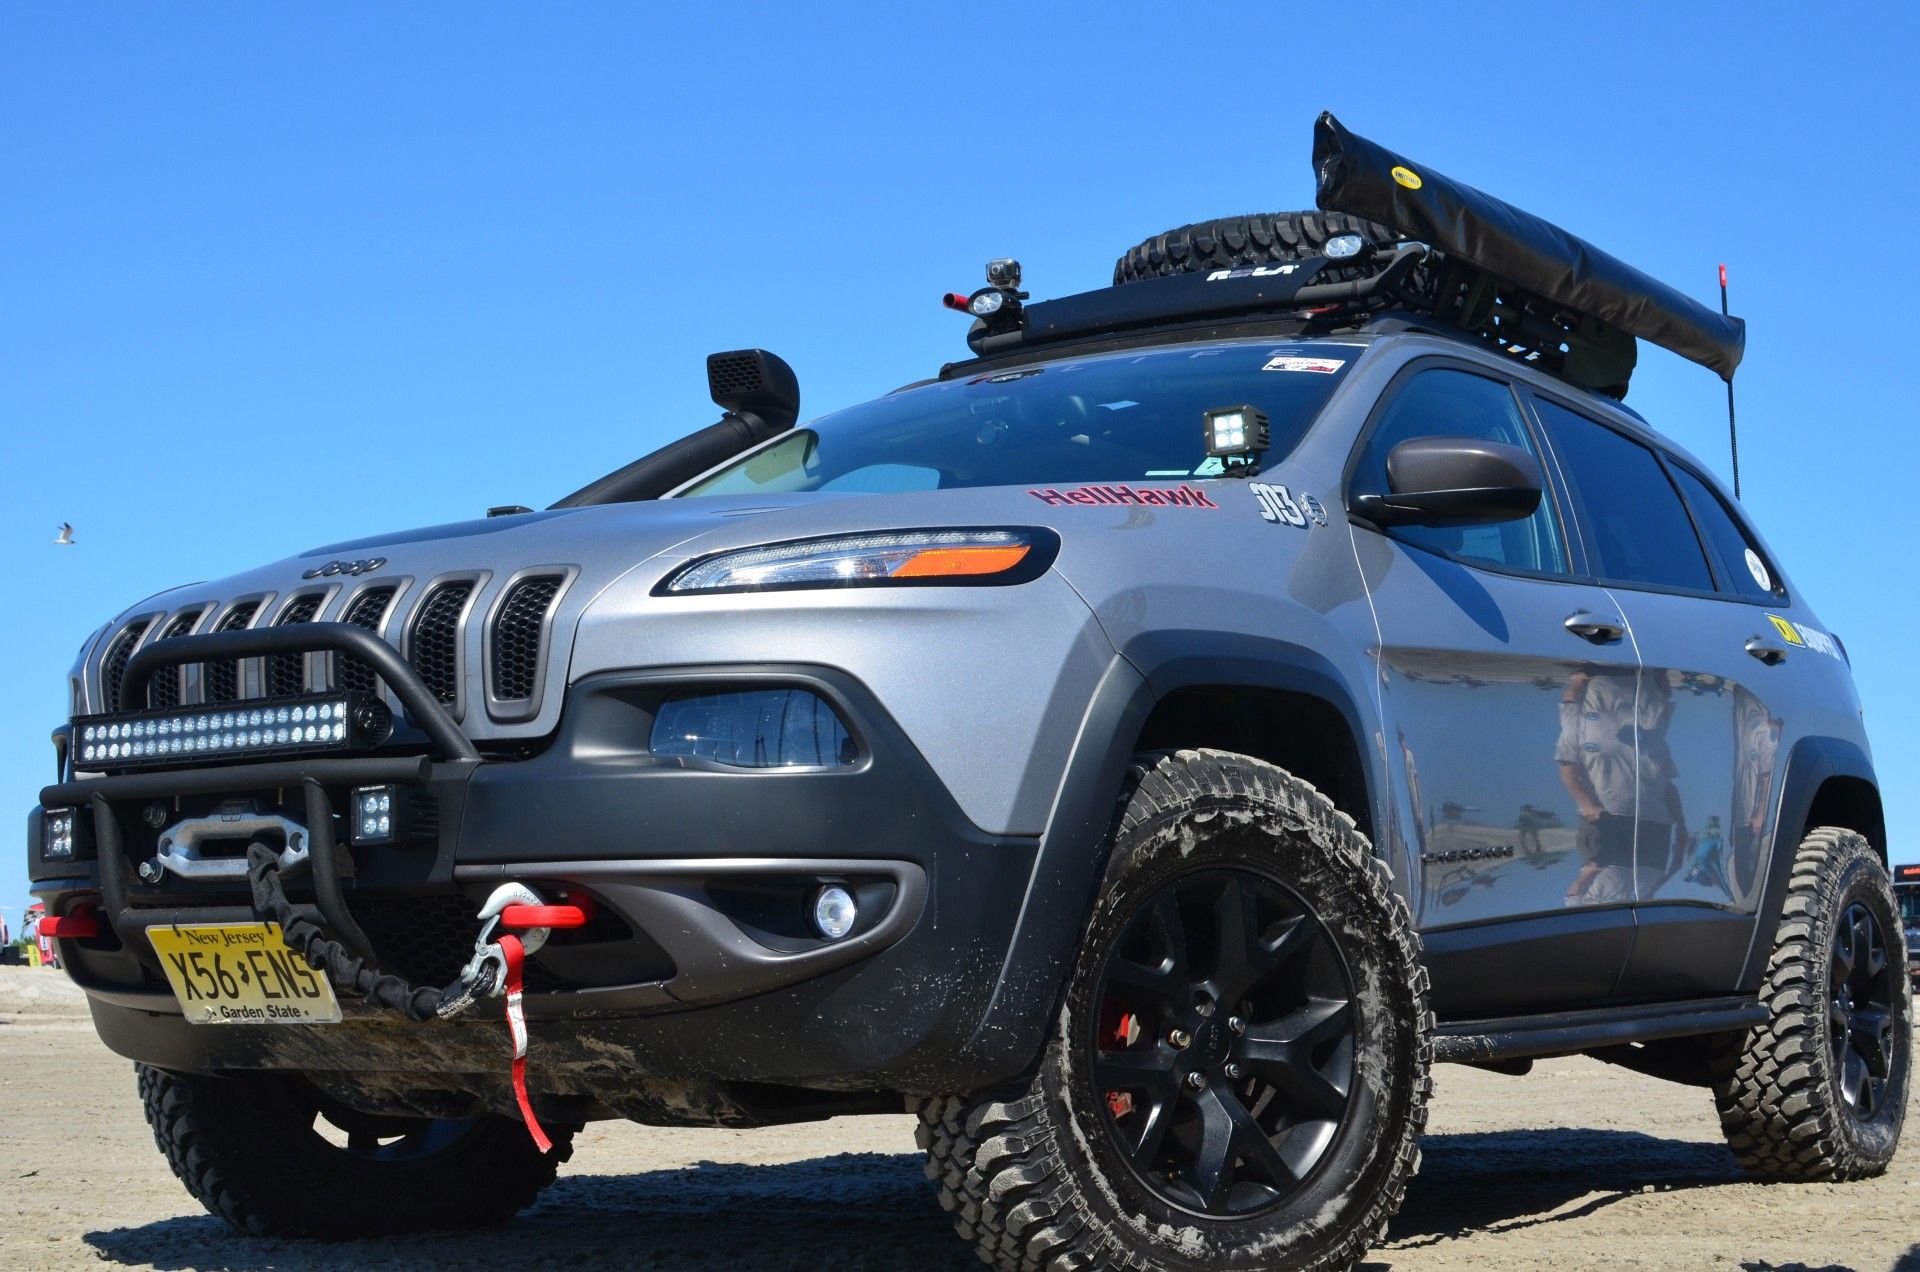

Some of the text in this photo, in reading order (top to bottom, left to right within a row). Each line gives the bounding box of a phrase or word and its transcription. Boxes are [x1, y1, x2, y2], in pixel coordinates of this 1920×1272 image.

[1027, 484, 1221, 509] HellHawk
[184, 930, 265, 947] New Jersey
[220, 1005, 301, 1018] Garden State
